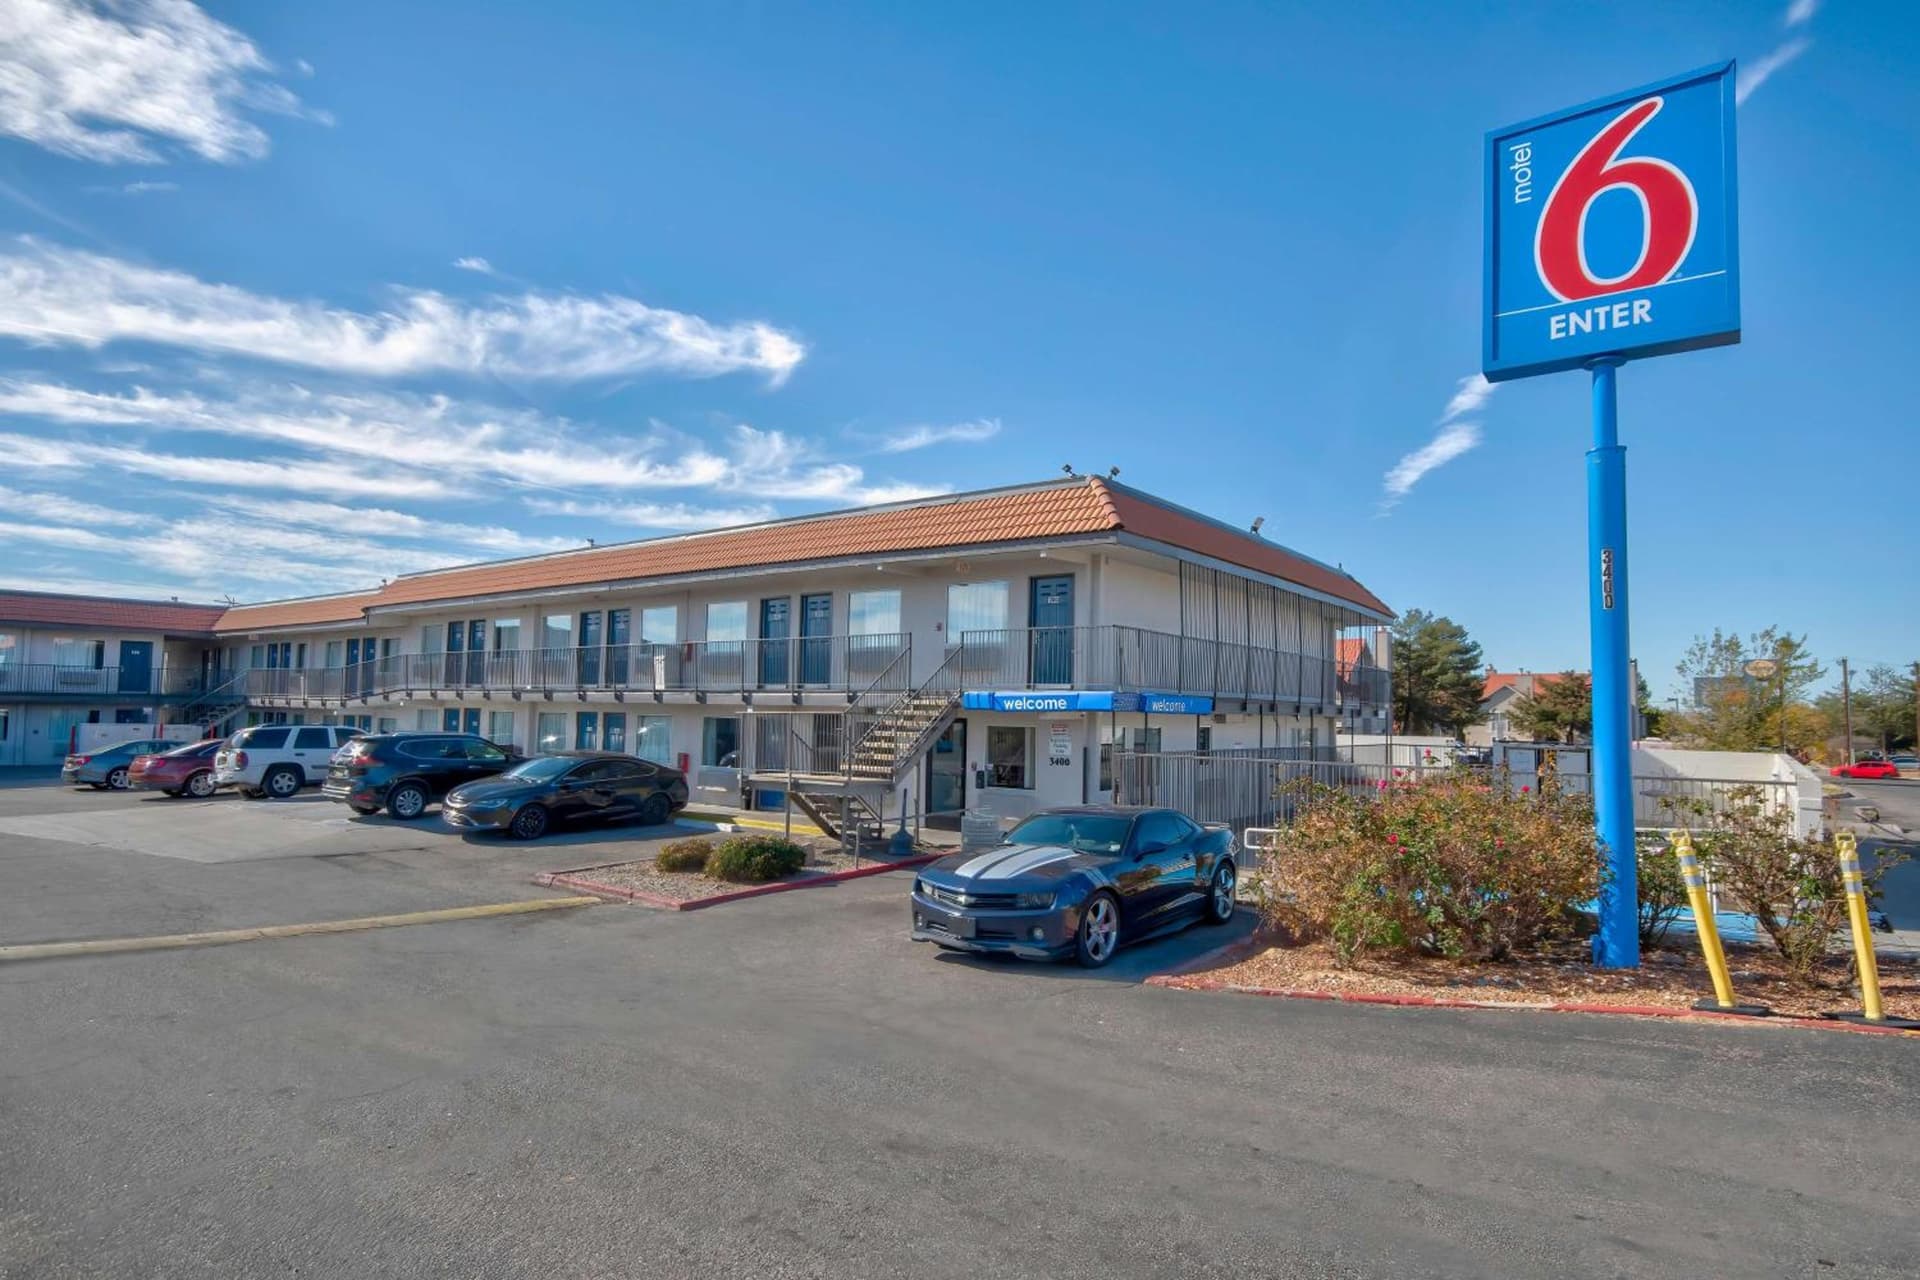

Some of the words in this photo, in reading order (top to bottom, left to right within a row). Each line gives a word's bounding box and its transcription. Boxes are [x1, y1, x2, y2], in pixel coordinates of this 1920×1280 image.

[1510, 142, 1532, 204] motel
[1534, 96, 1699, 303] 6
[1549, 299, 1653, 340] ENTER
[1602, 550, 1614, 609] 3400
[1003, 697, 1067, 710] welcome
[1152, 699, 1186, 712] welcome
[1050, 757, 1070, 767] 3400
